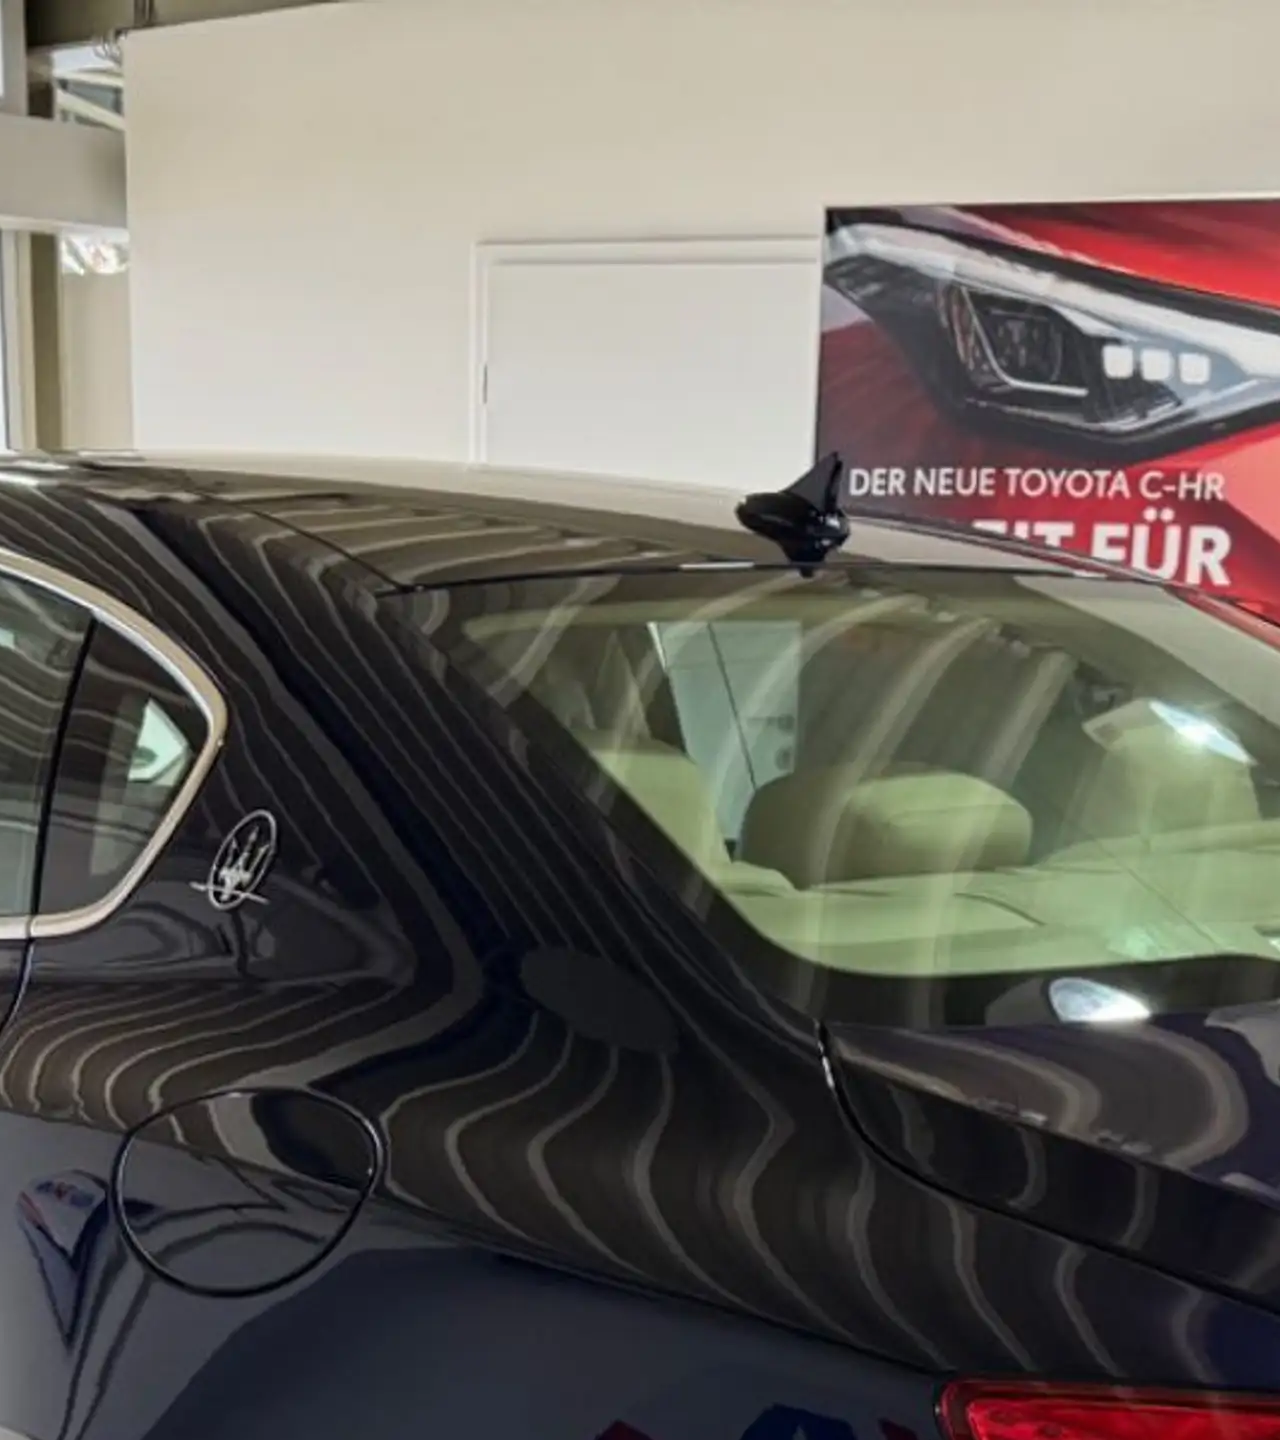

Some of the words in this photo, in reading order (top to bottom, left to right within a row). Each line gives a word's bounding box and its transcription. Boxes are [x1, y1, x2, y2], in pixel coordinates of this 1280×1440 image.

[849, 467, 906, 496] DER
[913, 467, 996, 496] NEUE
[1003, 467, 1130, 500] TOYOTA
[1139, 470, 1226, 501] C-HR
[1091, 506, 1233, 588] FÜR
